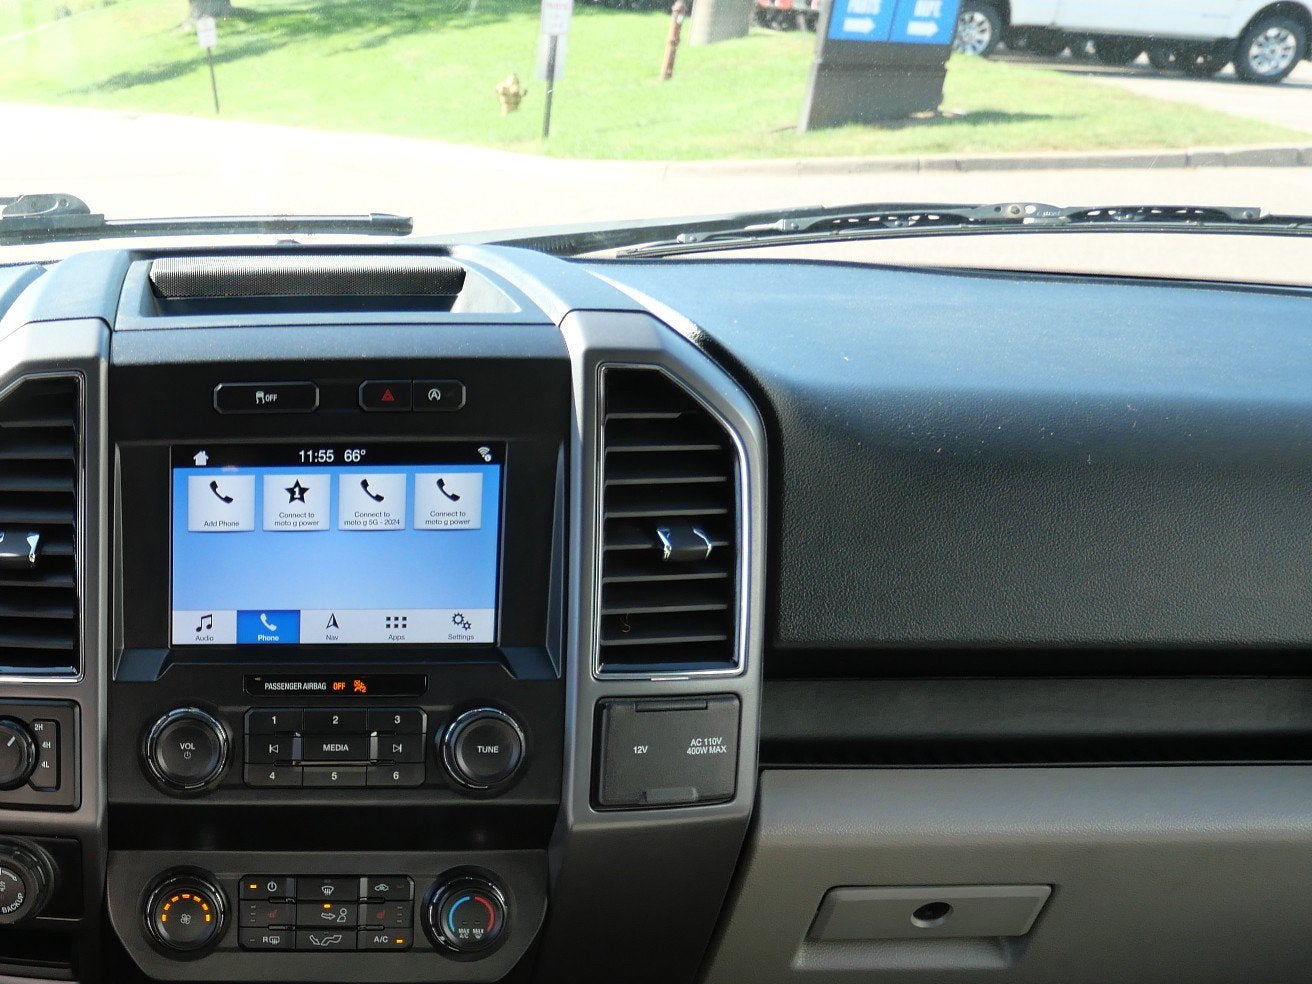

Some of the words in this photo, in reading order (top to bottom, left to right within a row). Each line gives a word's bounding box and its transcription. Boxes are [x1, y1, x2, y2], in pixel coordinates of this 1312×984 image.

[265, 394, 278, 402] OFF
[299, 449, 335, 463] 11:55
[307, 511, 315, 519] to
[429, 510, 457, 518] Connect
[298, 520, 319, 528] power
[449, 518, 471, 526] power
[257, 634, 279, 642] Phone
[388, 634, 405, 642] Apps
[447, 633, 475, 642] Settings
[264, 682, 302, 691] PASSENGER
[303, 682, 327, 691] AIRBAG
[333, 681, 346, 690] OFF
[271, 715, 277, 725] 1
[332, 715, 339, 725] 2
[394, 715, 401, 725] 3
[34, 723, 44, 731] 2H
[179, 742, 196, 750] VOL
[690, 738, 702, 747] AC
[704, 737, 723, 746] 110V
[322, 743, 349, 752] MEDIA
[477, 745, 499, 753] TUNE
[633, 745, 649, 754] 12V
[686, 746, 708, 755] 400W
[708, 745, 727, 754] MAX
[269, 771, 276, 780] 4
[331, 771, 338, 780] 5
[393, 771, 399, 780] 6
[1, 892, 24, 914] BACKUP
[373, 936, 389, 944] A/C
